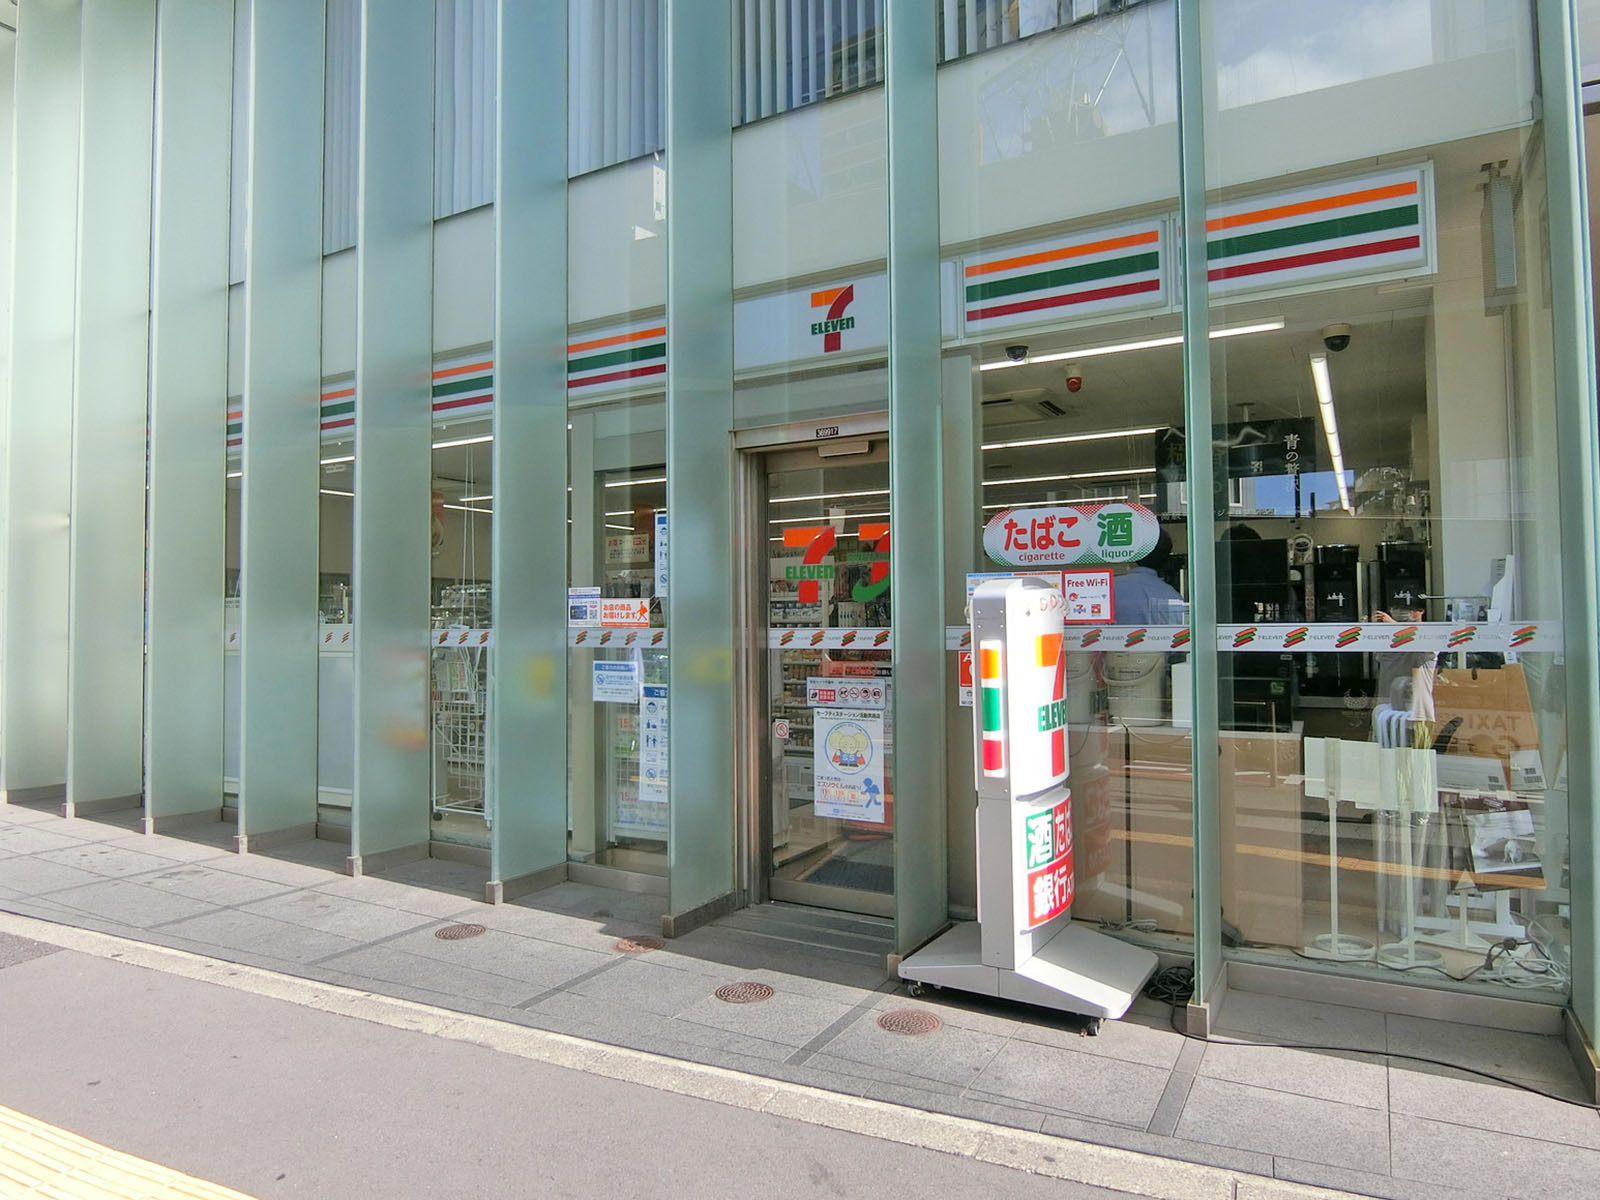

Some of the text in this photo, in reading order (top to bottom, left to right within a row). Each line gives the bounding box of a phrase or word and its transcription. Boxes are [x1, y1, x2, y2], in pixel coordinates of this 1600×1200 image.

[1003, 512, 1133, 551] たばこ 酒
[1018, 549, 1135, 563] cigarette liquor
[1067, 578, 1108, 588] Free Wi-Fi
[1029, 815, 1052, 866] 酒
